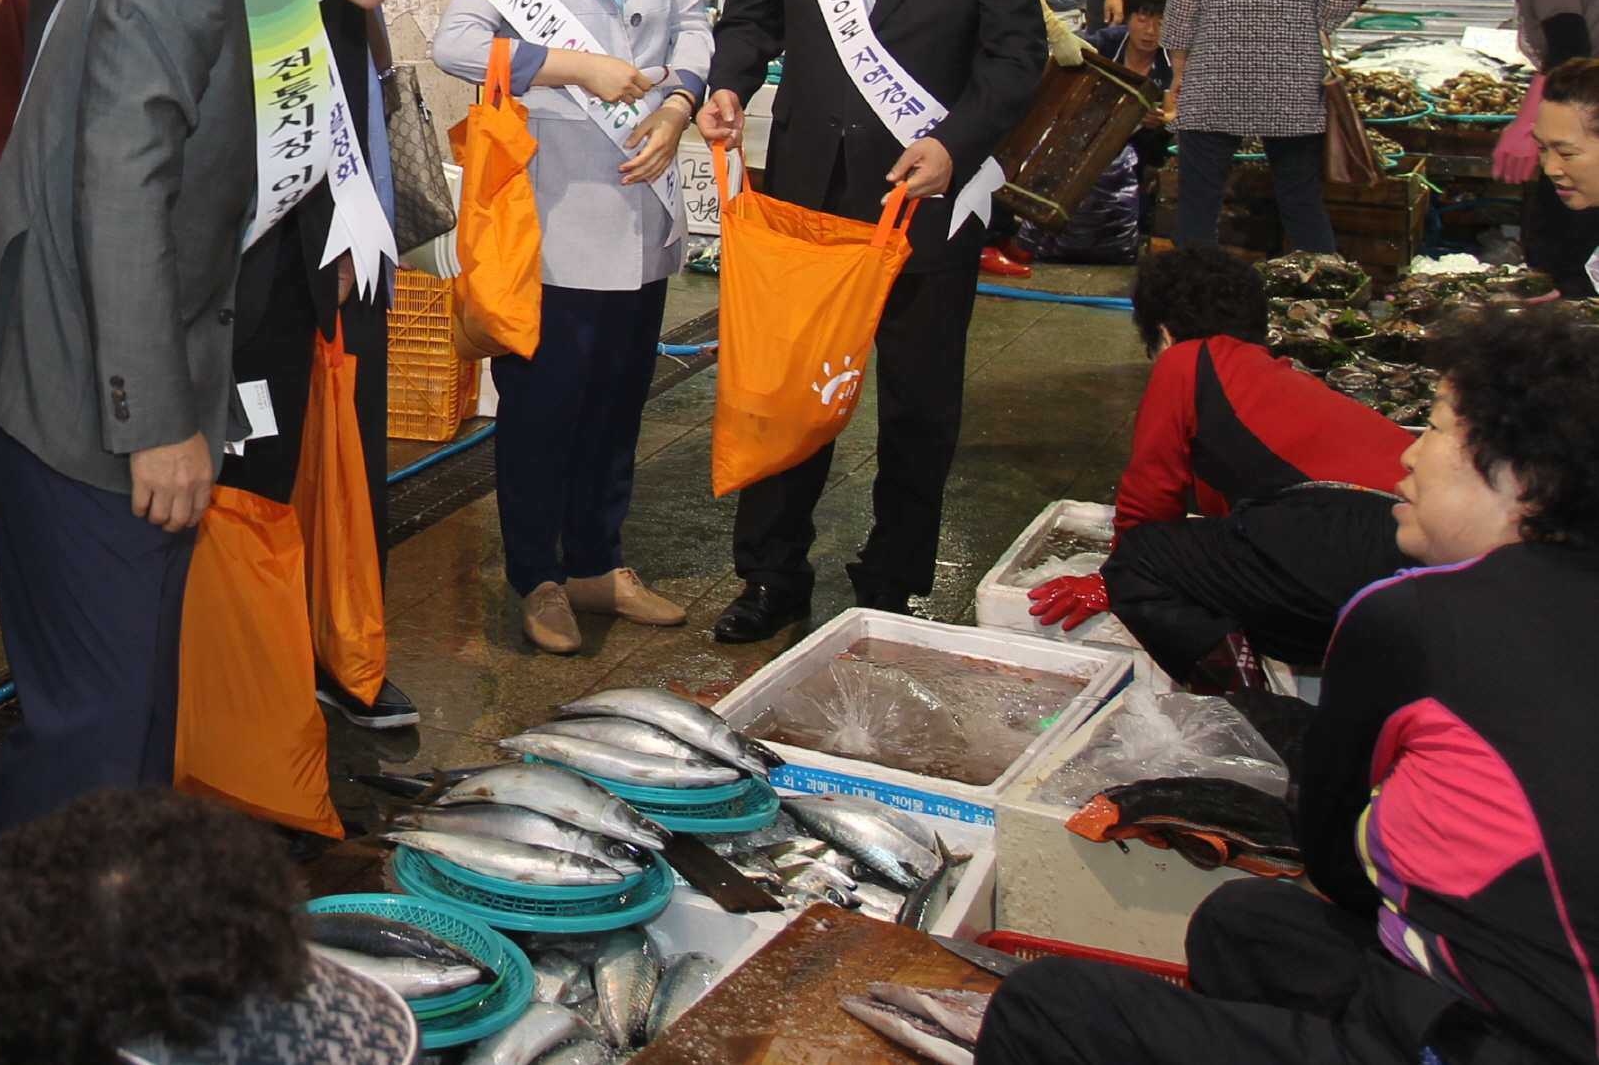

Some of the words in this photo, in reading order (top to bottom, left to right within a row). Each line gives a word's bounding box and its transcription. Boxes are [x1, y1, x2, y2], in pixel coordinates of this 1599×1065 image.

[268, 46, 319, 159] 전통시장
[850, 46, 926, 125] 지역경제
[686, 194, 721, 224] 만원
